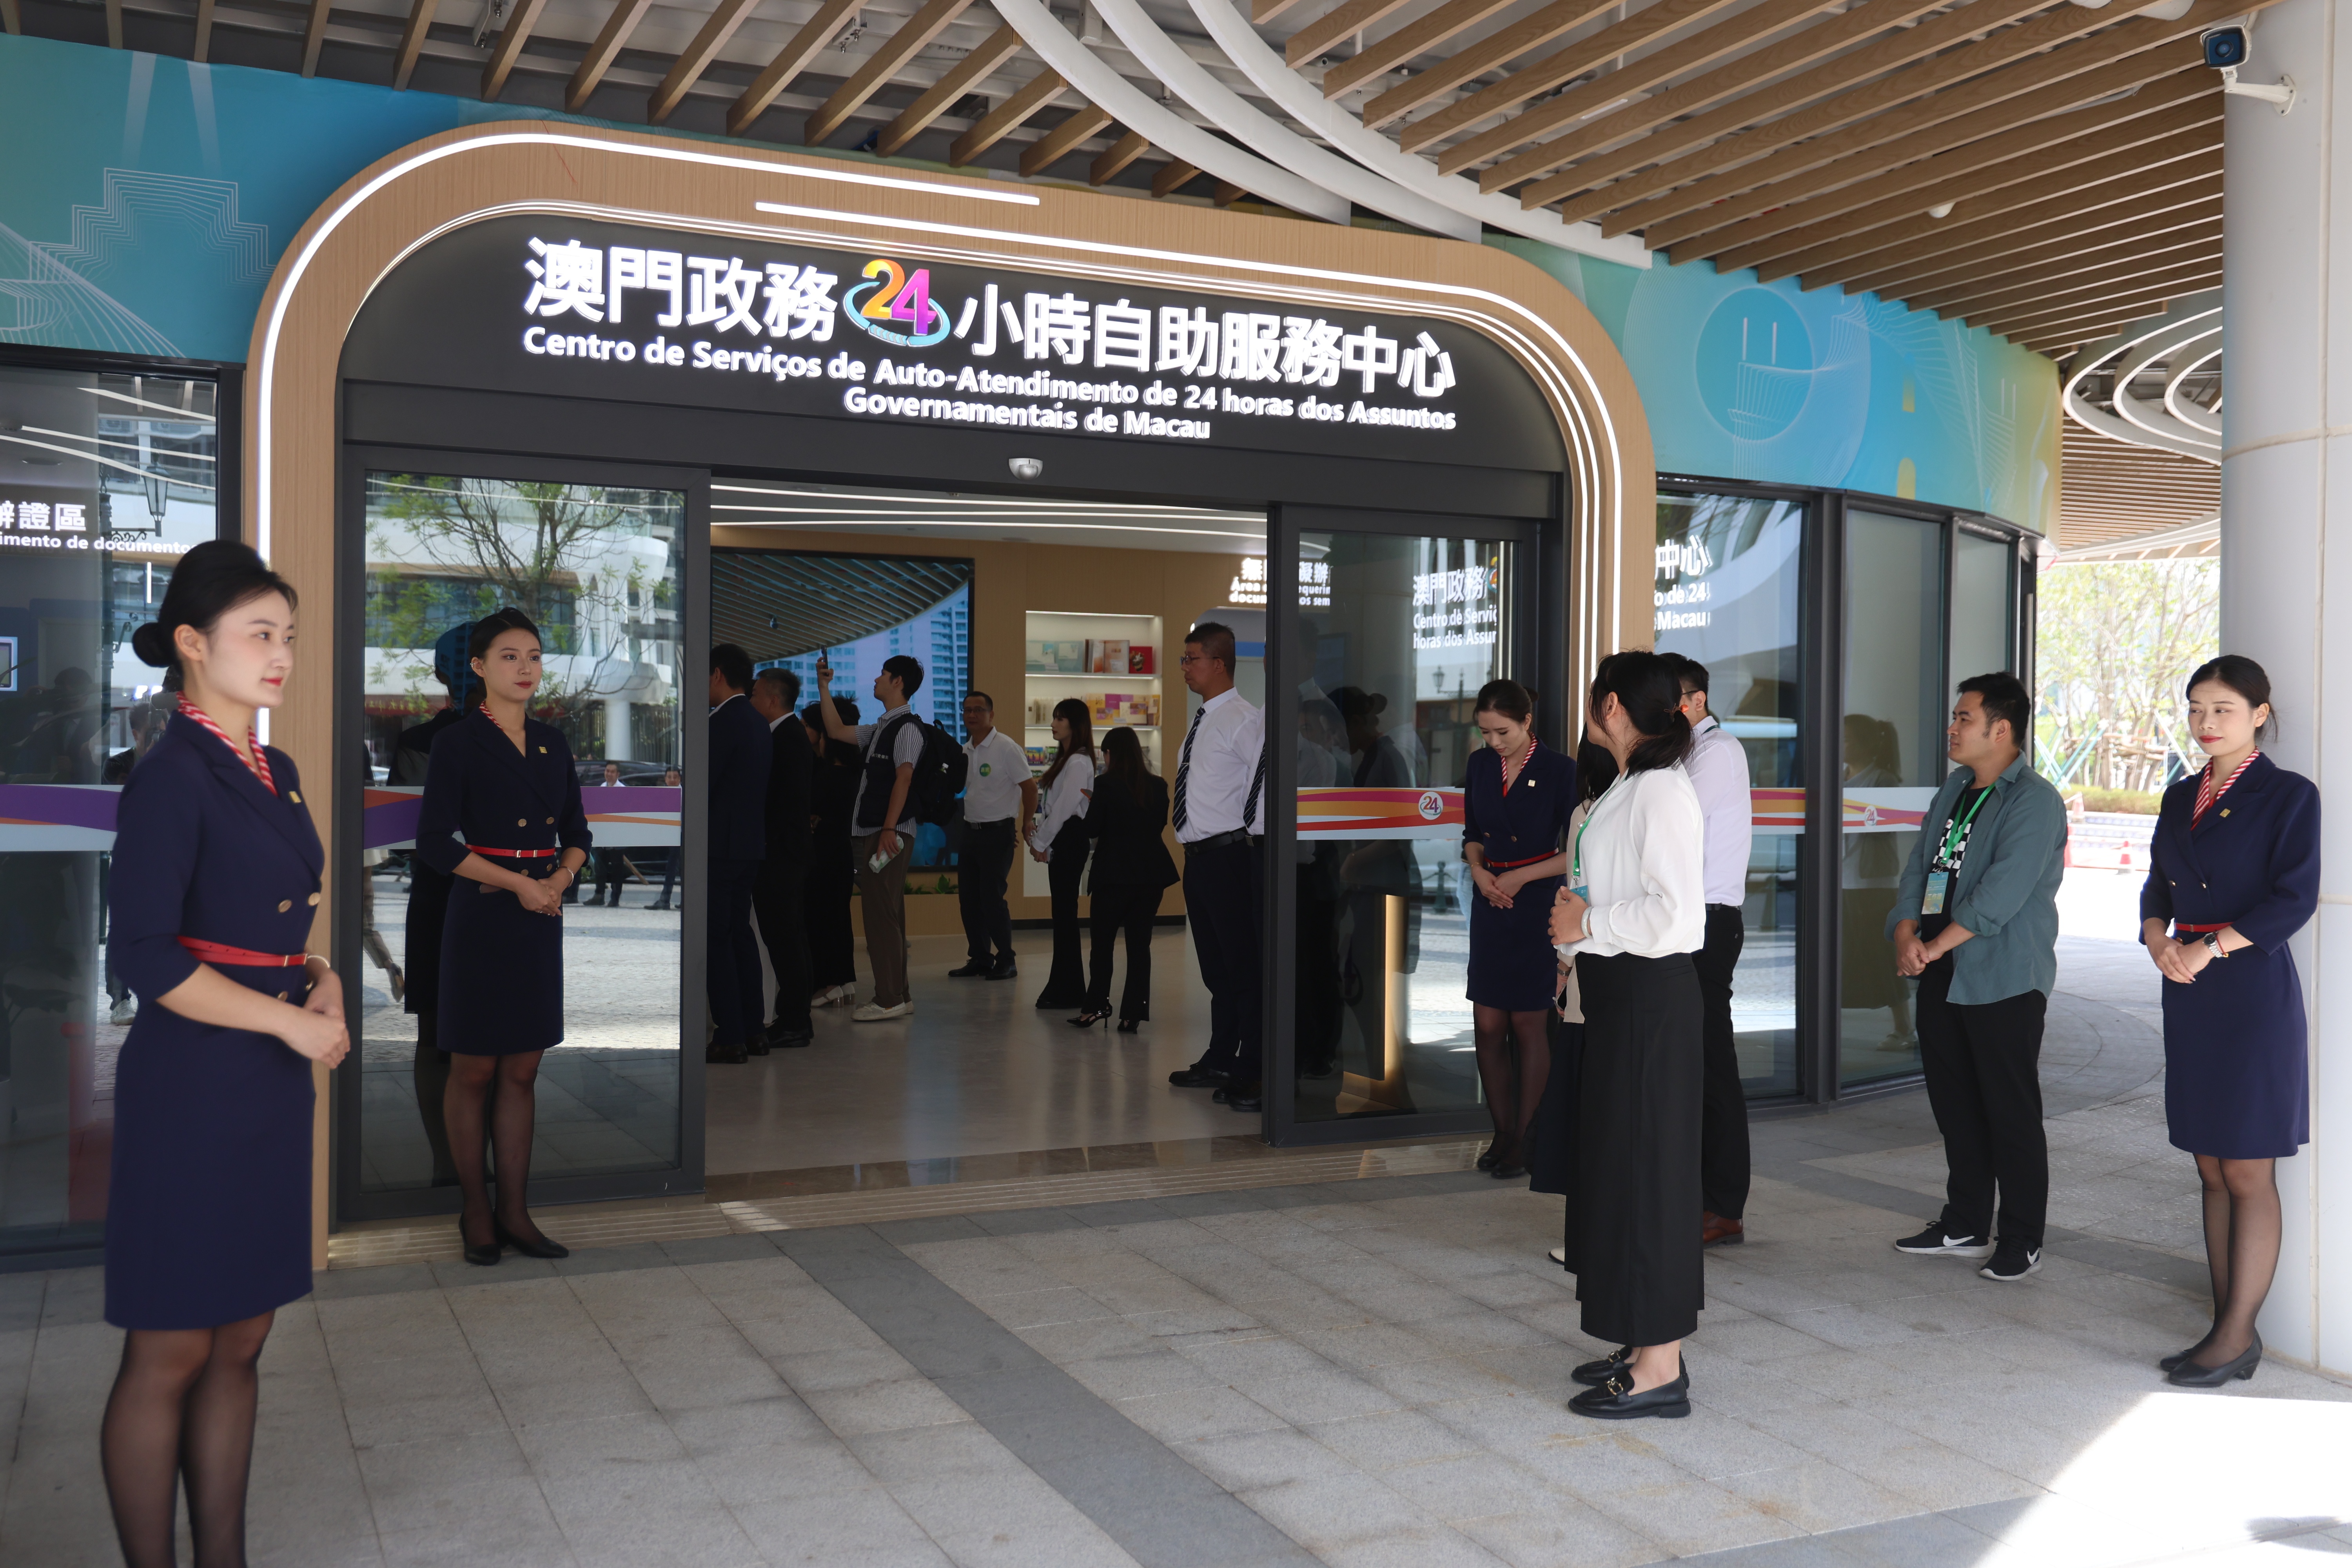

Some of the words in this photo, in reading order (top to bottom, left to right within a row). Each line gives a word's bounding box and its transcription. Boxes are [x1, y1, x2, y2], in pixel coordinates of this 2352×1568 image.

[524, 236, 838, 343] 澳門政務
[861, 258, 938, 336] 24
[954, 283, 1457, 397] 小時自助服務中心
[523, 326, 636, 362] Centro
[644, 336, 685, 366] de
[693, 341, 822, 381] Serviços
[828, 351, 866, 381] de
[873, 359, 1138, 404] Auto-Atendimento
[1143, 380, 1178, 406] de
[1183, 385, 1218, 410] 24
[1222, 387, 1294, 416] horas
[1298, 395, 1345, 422] dos
[1347, 400, 1456, 430] Assuntos
[844, 387, 1078, 430] Governamentais
[1084, 407, 1118, 433] de
[1123, 410, 1210, 439] Macau
[67, 535, 88, 550] de
[94, 536, 197, 554] documento
[1655, 534, 1712, 579] 中心
[1230, 576, 1261, 592] Área
[1412, 566, 1486, 606] 澳門政務
[1667, 584, 1685, 604] de
[1688, 582, 1706, 603] 24
[1413, 613, 1448, 629] Centro
[1450, 608, 1463, 626] de
[1657, 610, 1706, 630] Macau
[1413, 632, 1441, 649] horas
[1445, 630, 1463, 647] dos
[1423, 795, 1439, 813] 24
